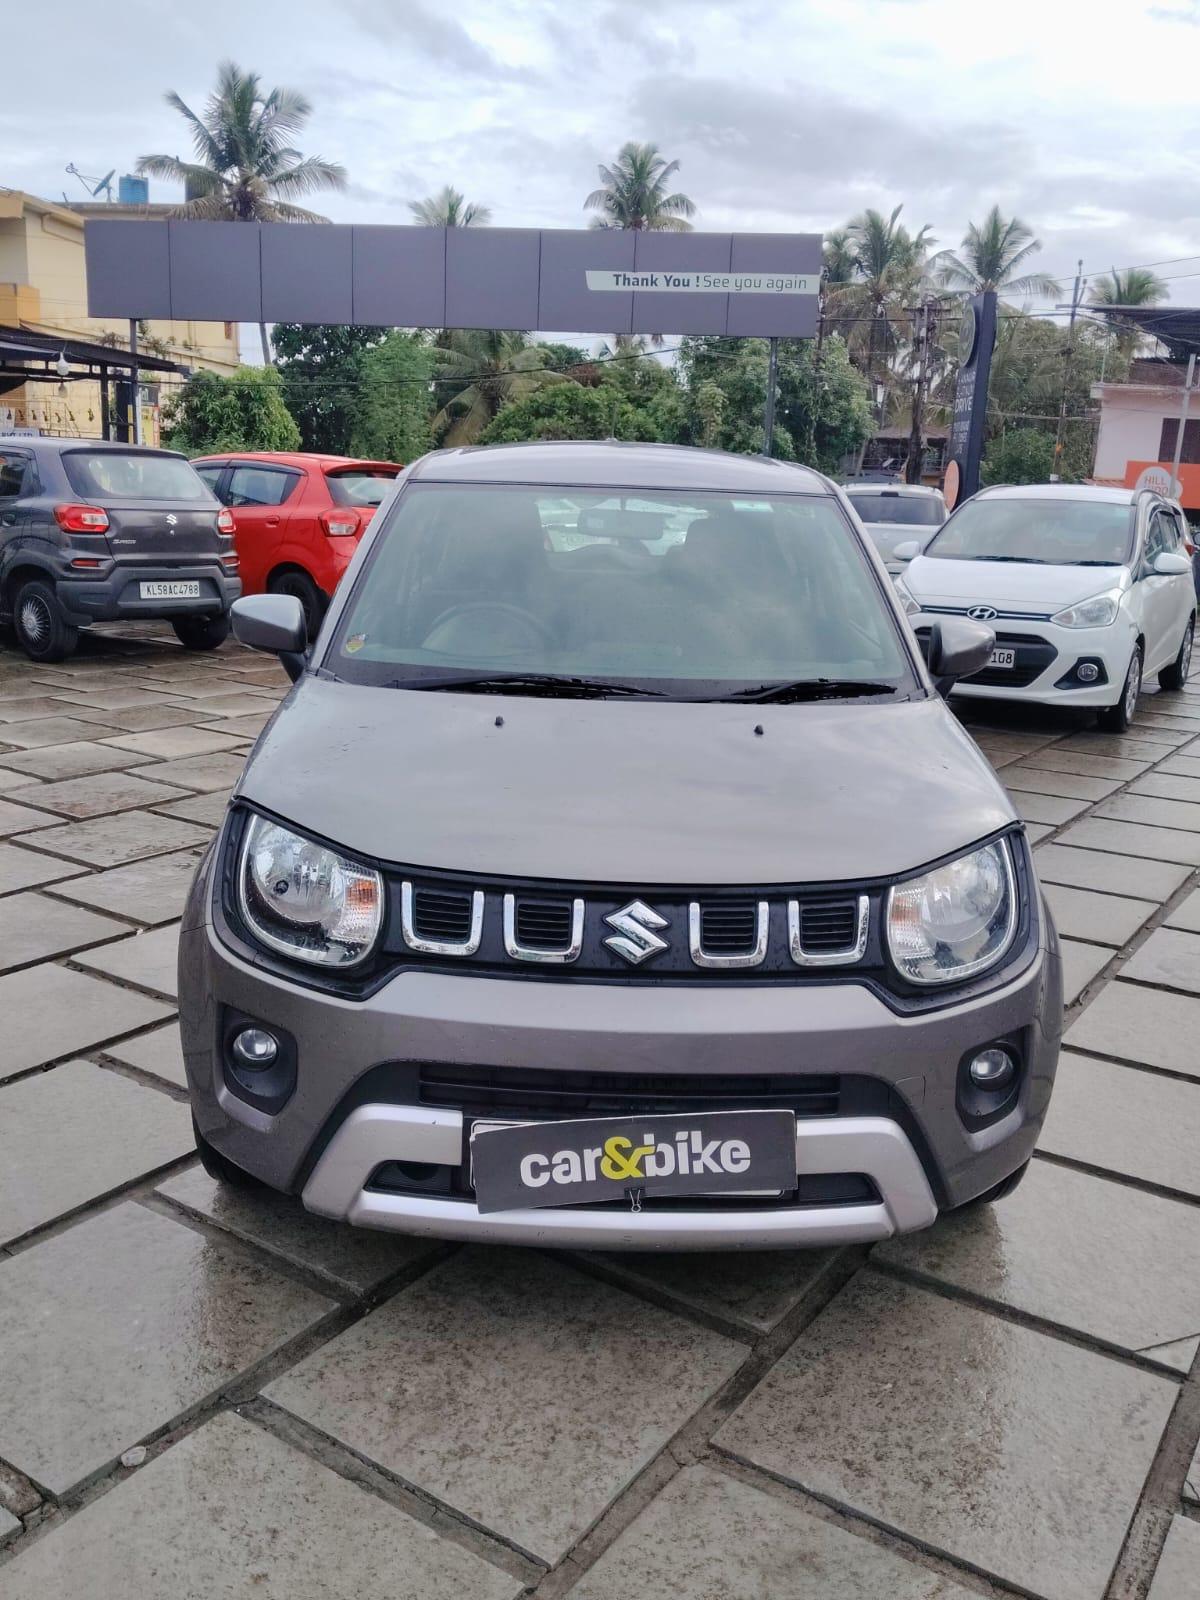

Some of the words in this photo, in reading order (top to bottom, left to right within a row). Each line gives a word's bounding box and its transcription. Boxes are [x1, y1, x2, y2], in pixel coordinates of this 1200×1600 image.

[612, 273, 660, 287] Thank
[663, 274, 690, 288] You
[703, 274, 730, 288] See
[734, 278, 762, 291] you
[766, 274, 807, 292] again
[1143, 474, 1168, 486] HILL
